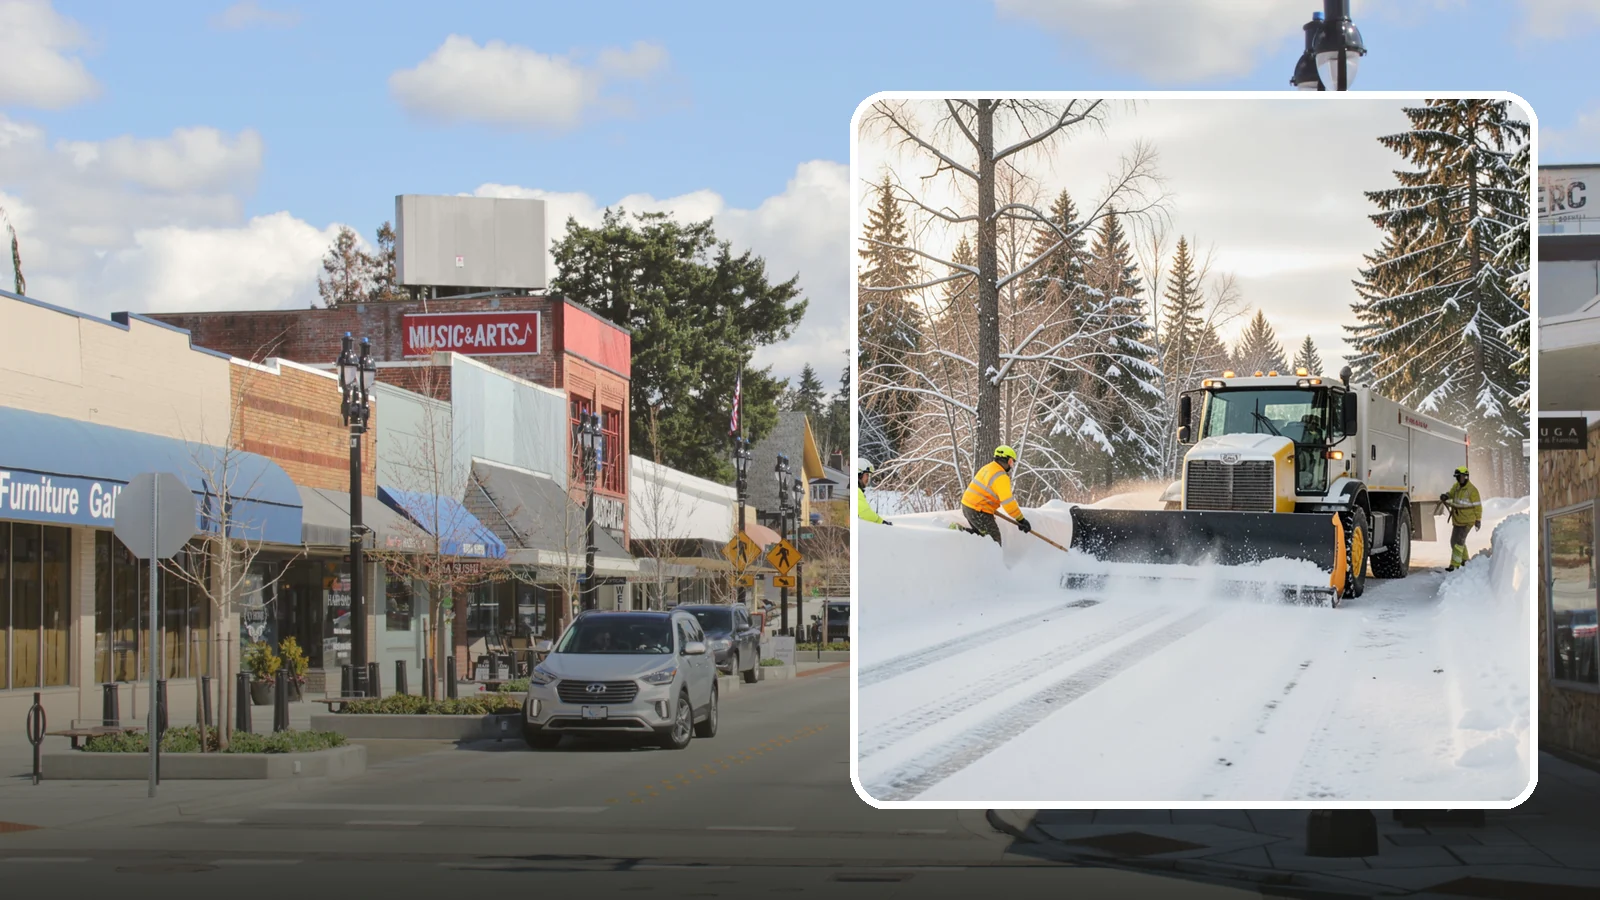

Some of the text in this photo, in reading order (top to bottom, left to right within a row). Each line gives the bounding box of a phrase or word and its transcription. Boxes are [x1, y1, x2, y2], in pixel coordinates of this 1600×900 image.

[409, 323, 519, 349] MUSIC&ARTS
[0, 471, 121, 518] Furniture Gal
[453, 563, 479, 574] SUSHI
